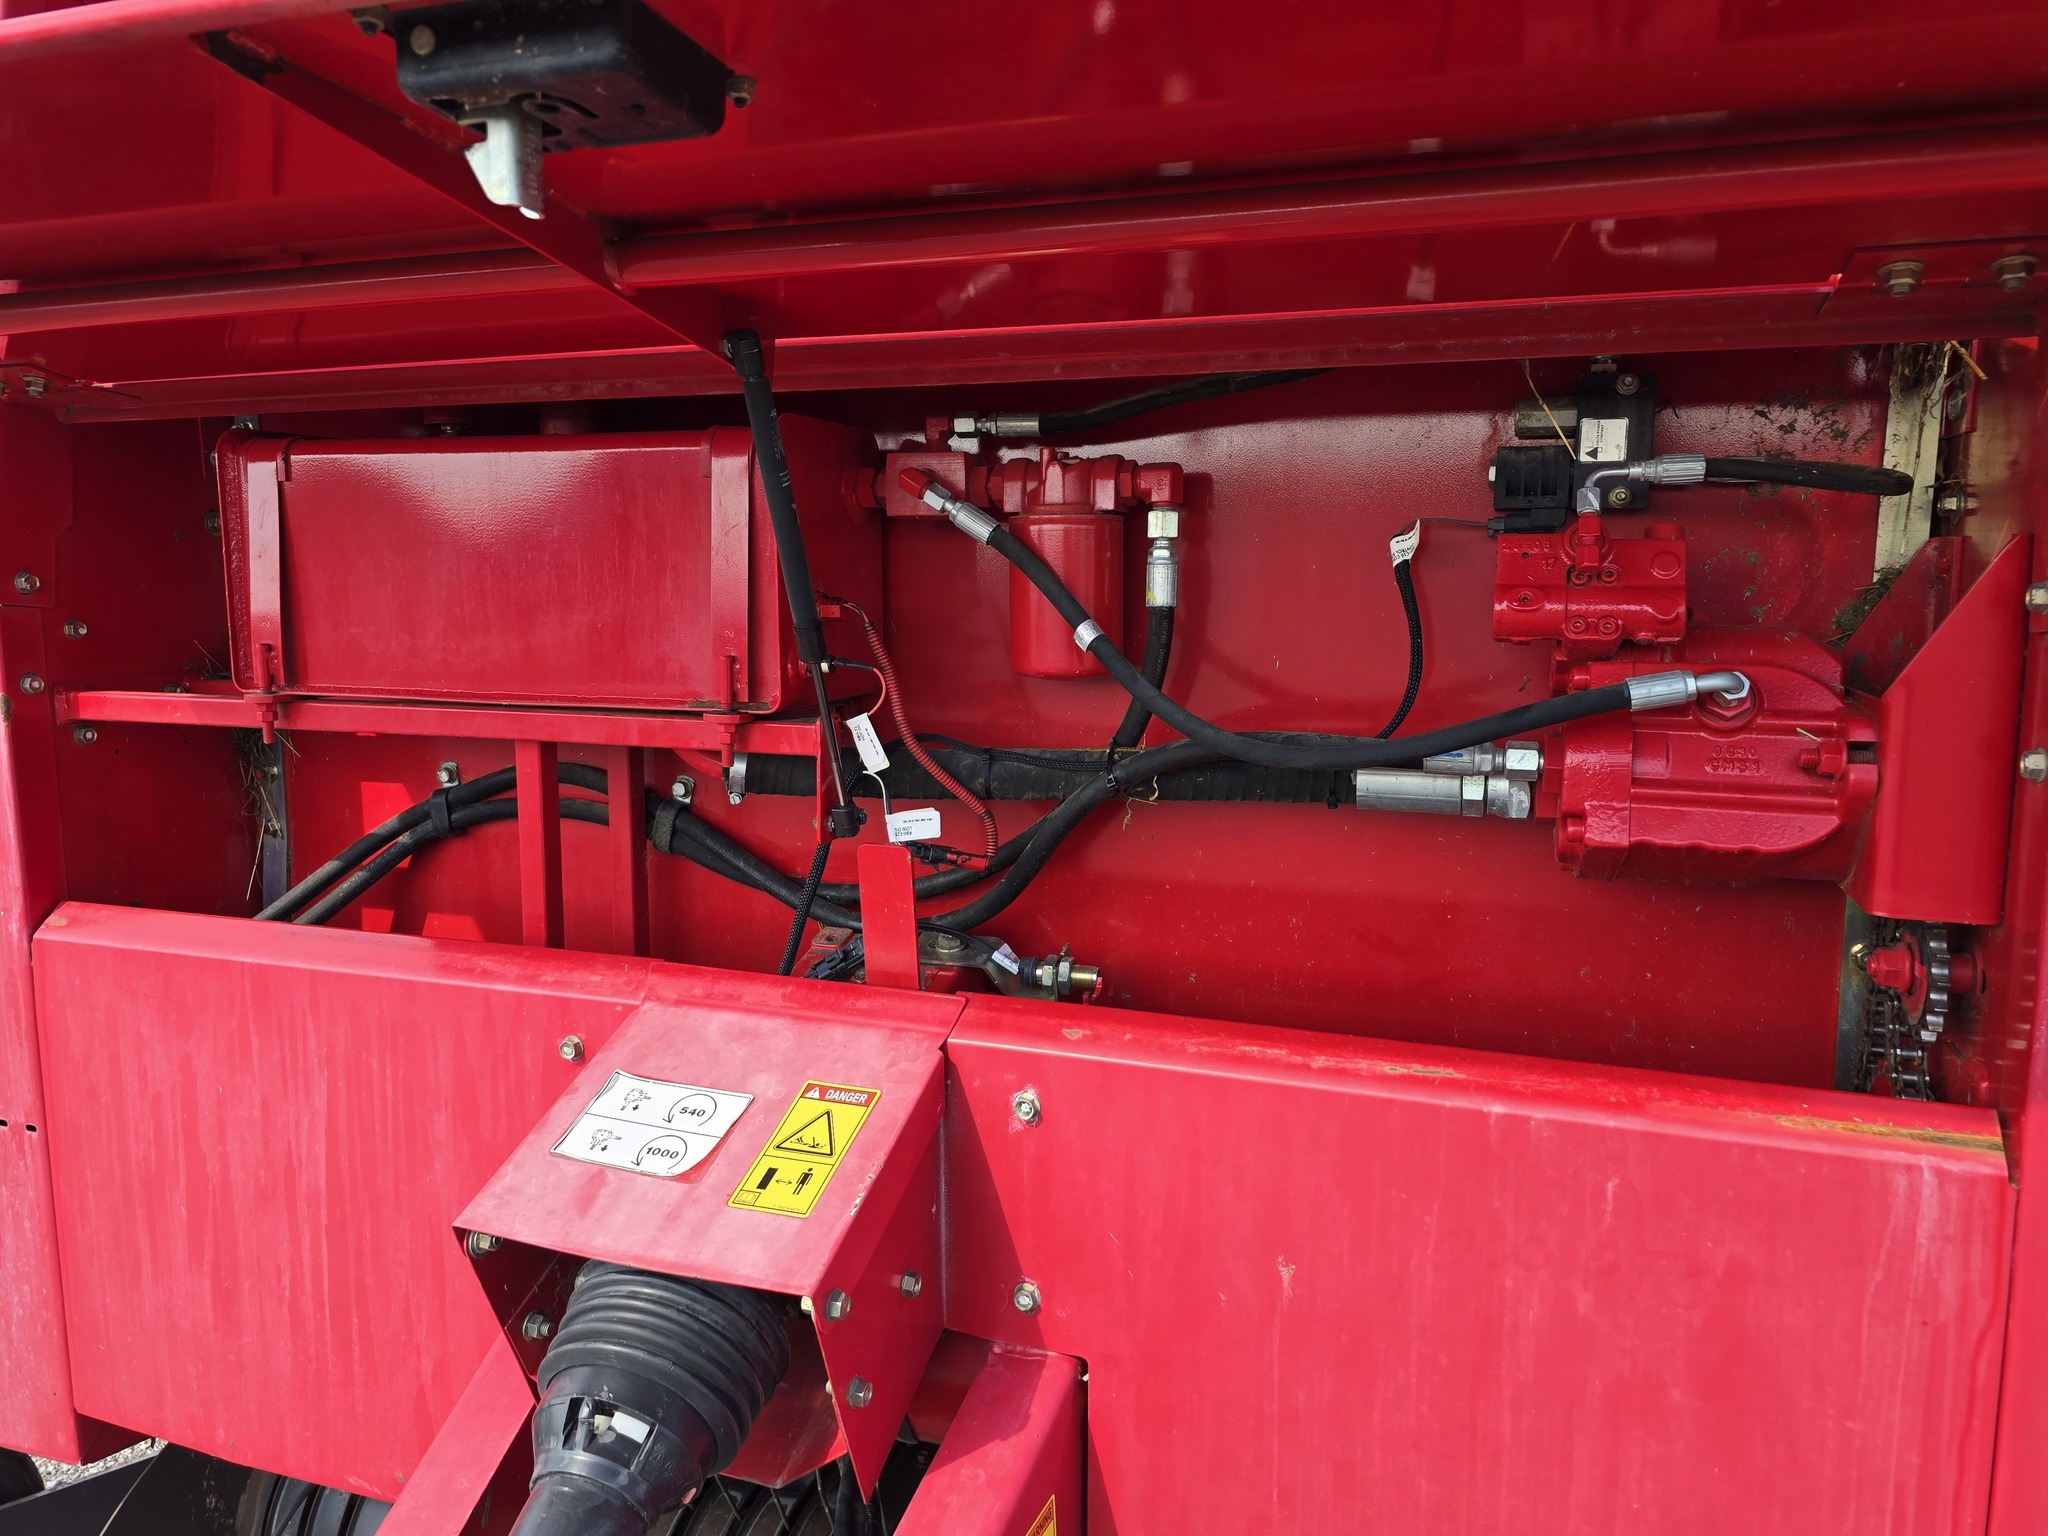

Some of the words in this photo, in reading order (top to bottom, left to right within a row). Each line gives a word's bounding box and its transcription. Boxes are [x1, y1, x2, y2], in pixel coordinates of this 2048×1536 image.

[825, 1089, 869, 1104] DANGER
[679, 1105, 706, 1118] 540
[646, 1146, 680, 1160] 1000
